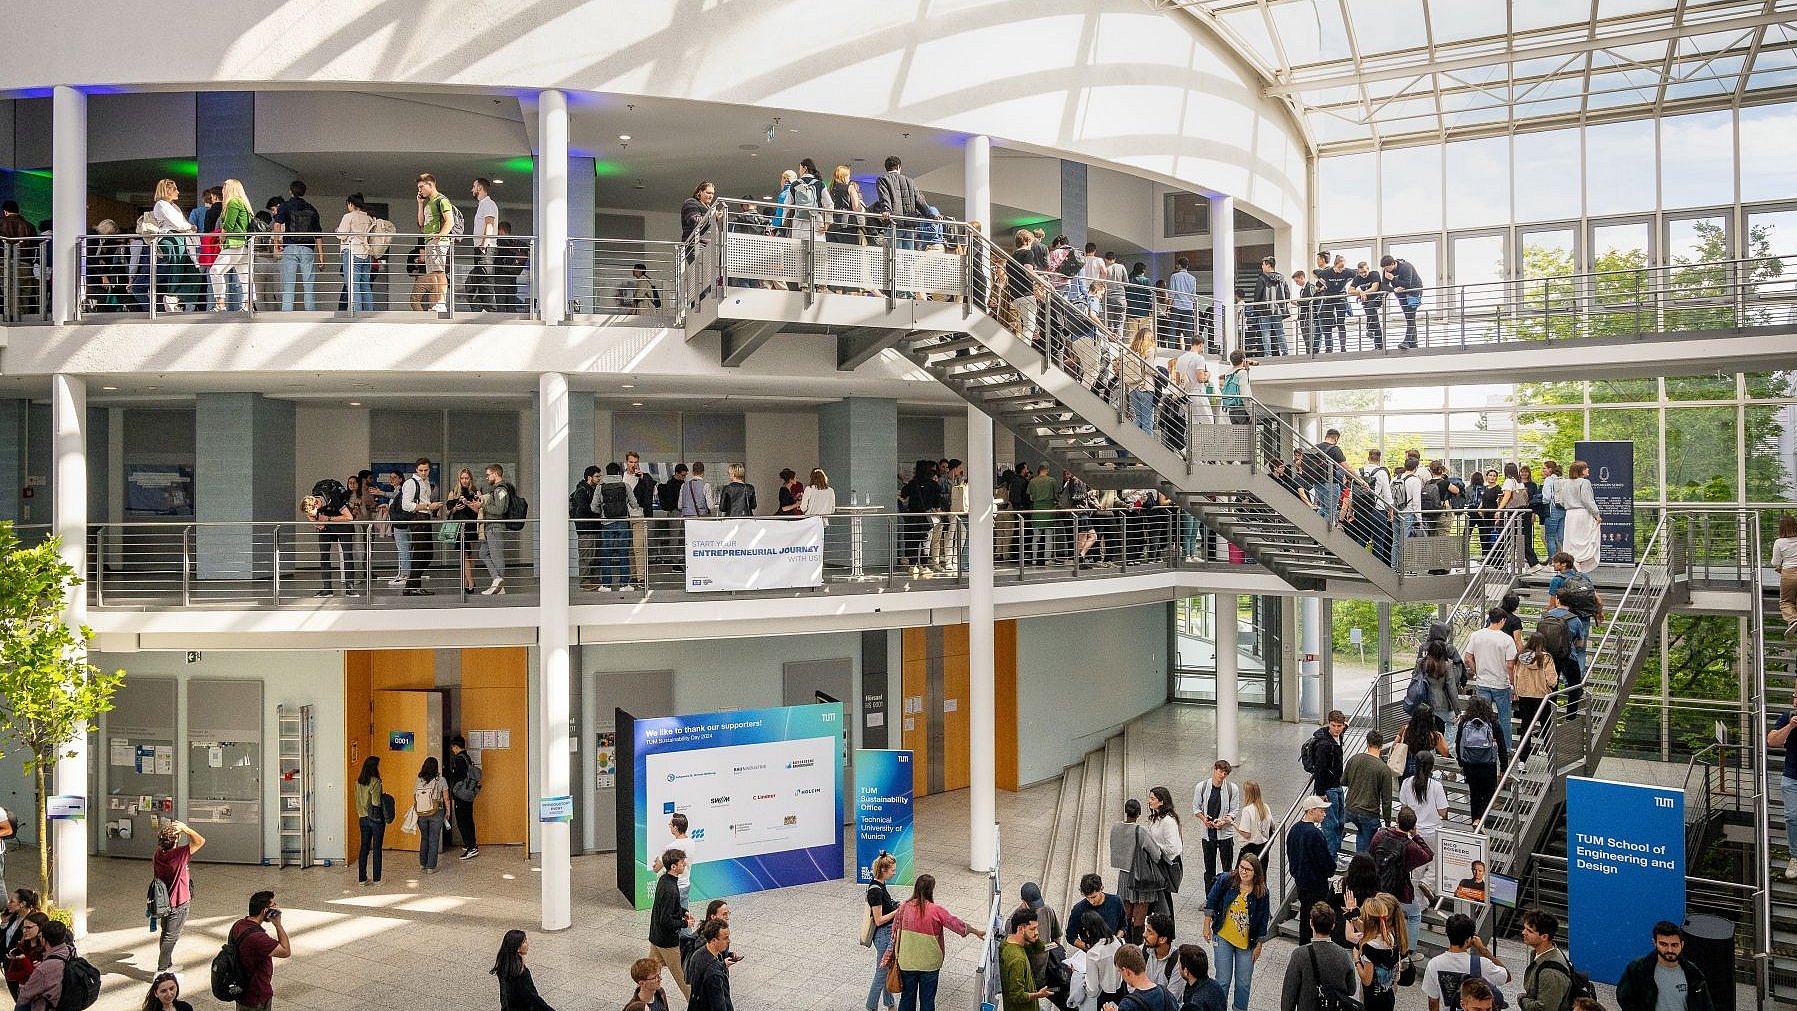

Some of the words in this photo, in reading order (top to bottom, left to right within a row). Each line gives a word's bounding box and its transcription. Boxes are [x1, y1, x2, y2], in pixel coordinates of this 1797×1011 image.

[692, 548, 777, 557] ENTREPRENEURIAL
[779, 545, 819, 555] JOURNEY
[645, 729, 658, 737] We
[659, 727, 673, 736] like
[675, 726, 683, 734] to
[685, 724, 705, 733] thank
[707, 723, 720, 731] our
[721, 719, 762, 732] supporters!
[394, 737, 408, 745] 0001
[897, 755, 909, 763] TUM
[861, 795, 909, 805] Sustainability
[1654, 796, 1674, 808] TUM
[861, 803, 883, 811] Office
[861, 815, 892, 823] Technical
[861, 824, 894, 833] University
[861, 832, 886, 840] Munich
[1576, 833, 1604, 846] TUM
[1607, 838, 1650, 853] School
[1652, 845, 1666, 855] of
[1576, 846, 1649, 868] Engineering
[1651, 859, 1675, 870] and
[1576, 859, 1618, 875] Design
